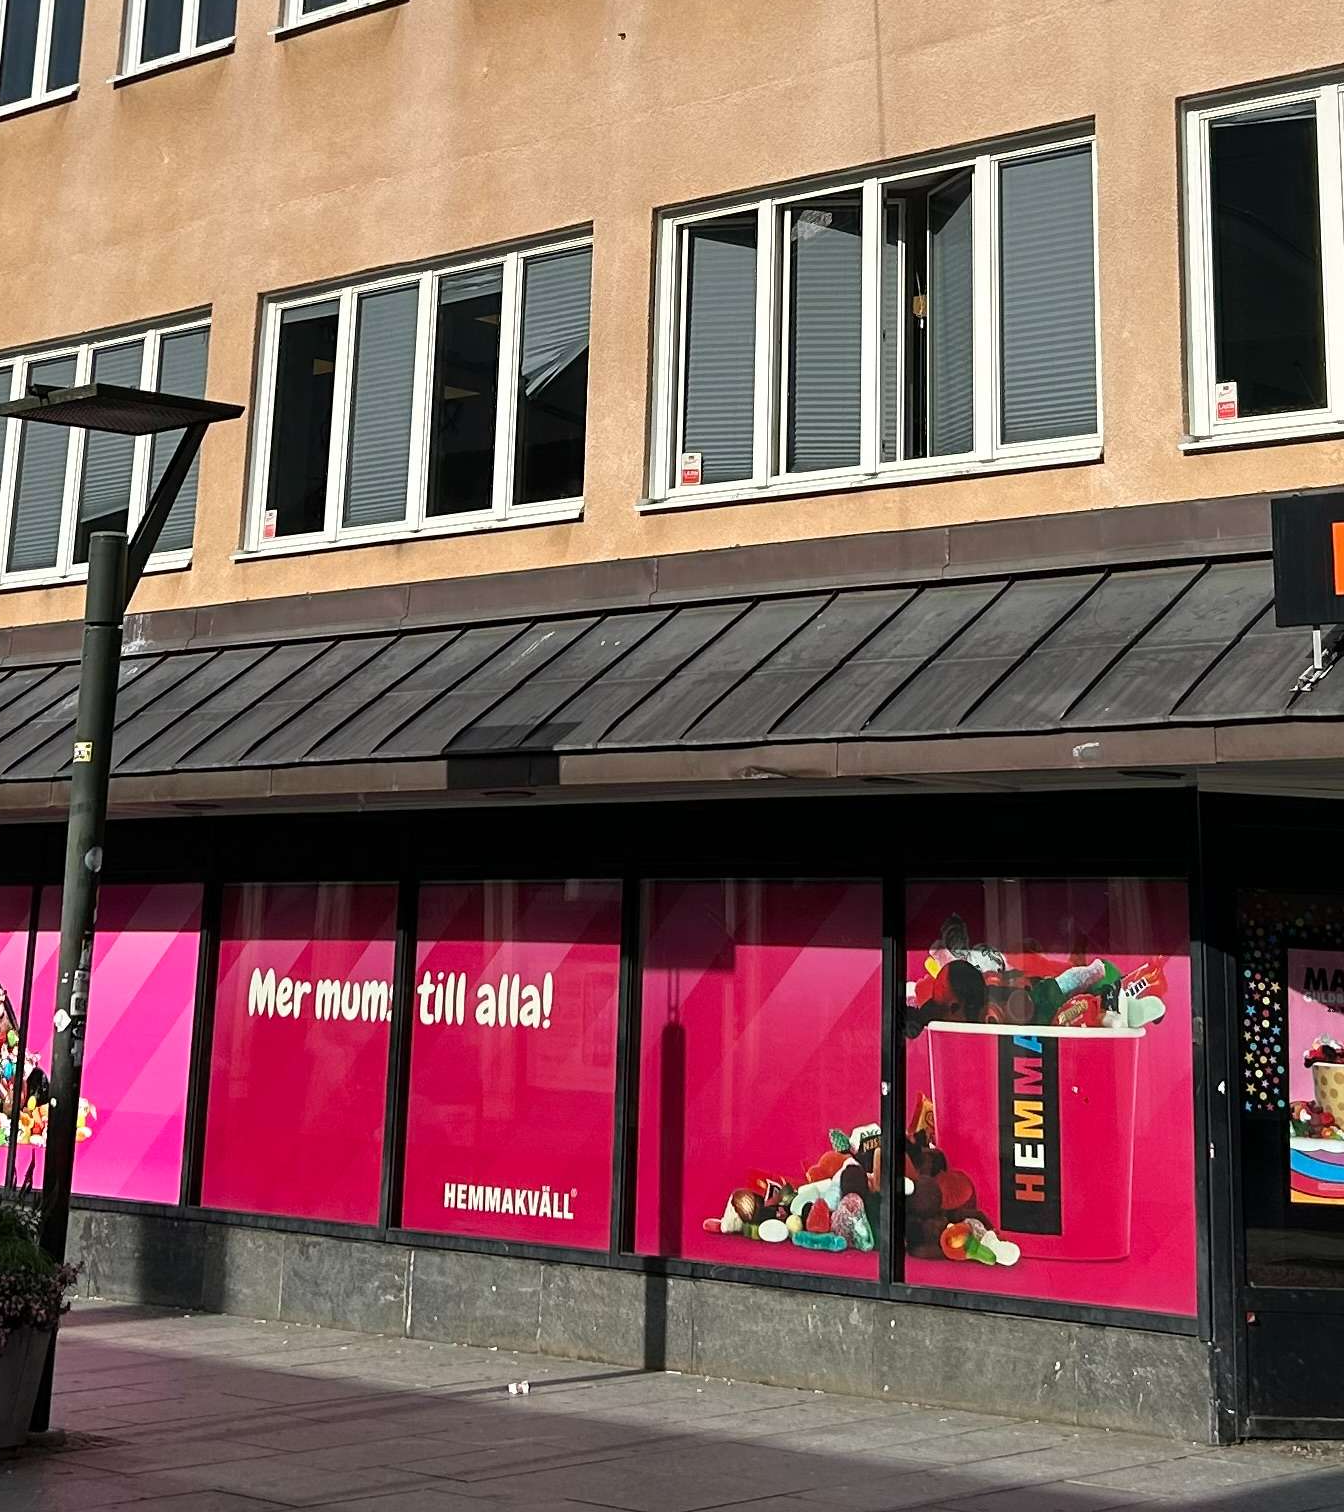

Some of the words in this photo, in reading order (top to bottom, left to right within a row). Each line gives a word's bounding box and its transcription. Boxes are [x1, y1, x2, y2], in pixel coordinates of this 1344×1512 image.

[248, 968, 310, 1019] Mer
[417, 970, 465, 1027] till
[475, 972, 553, 1029] alla!
[443, 1183, 574, 1221] HEMMAKVÄLL
